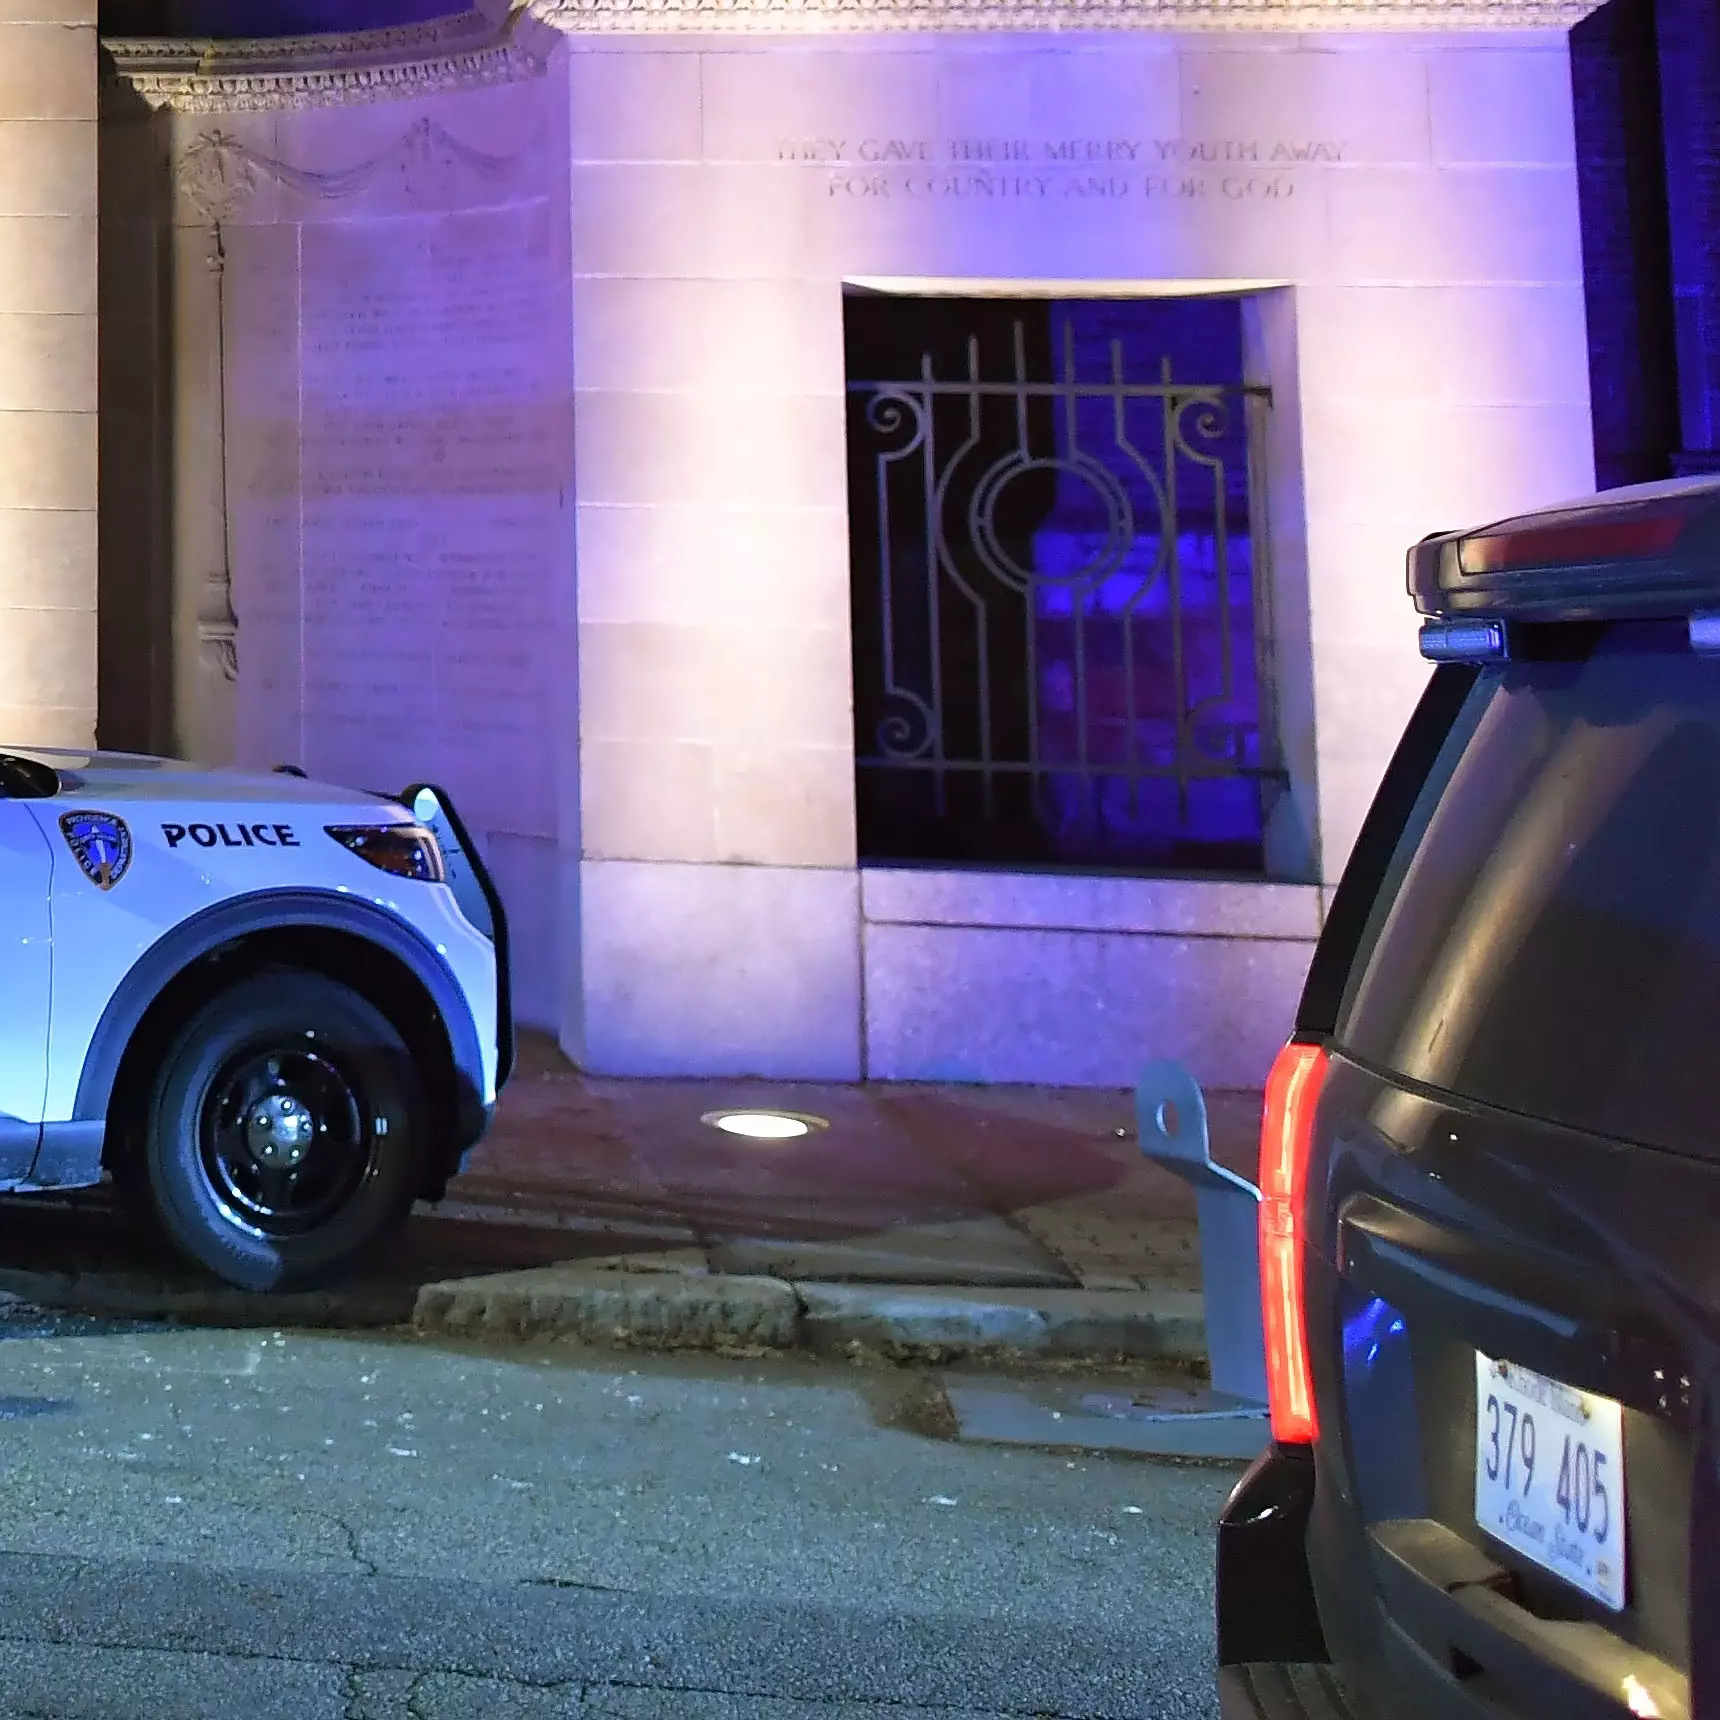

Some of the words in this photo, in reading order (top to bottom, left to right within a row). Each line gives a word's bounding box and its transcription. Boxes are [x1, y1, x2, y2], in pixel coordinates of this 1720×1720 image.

[774, 139, 847, 161] THEY
[1270, 139, 1350, 161] AWAY
[1063, 176, 1129, 199] AND
[161, 823, 301, 848] POLICE
[1486, 1393, 1536, 1498] 379
[1556, 1433, 1609, 1546] 405
